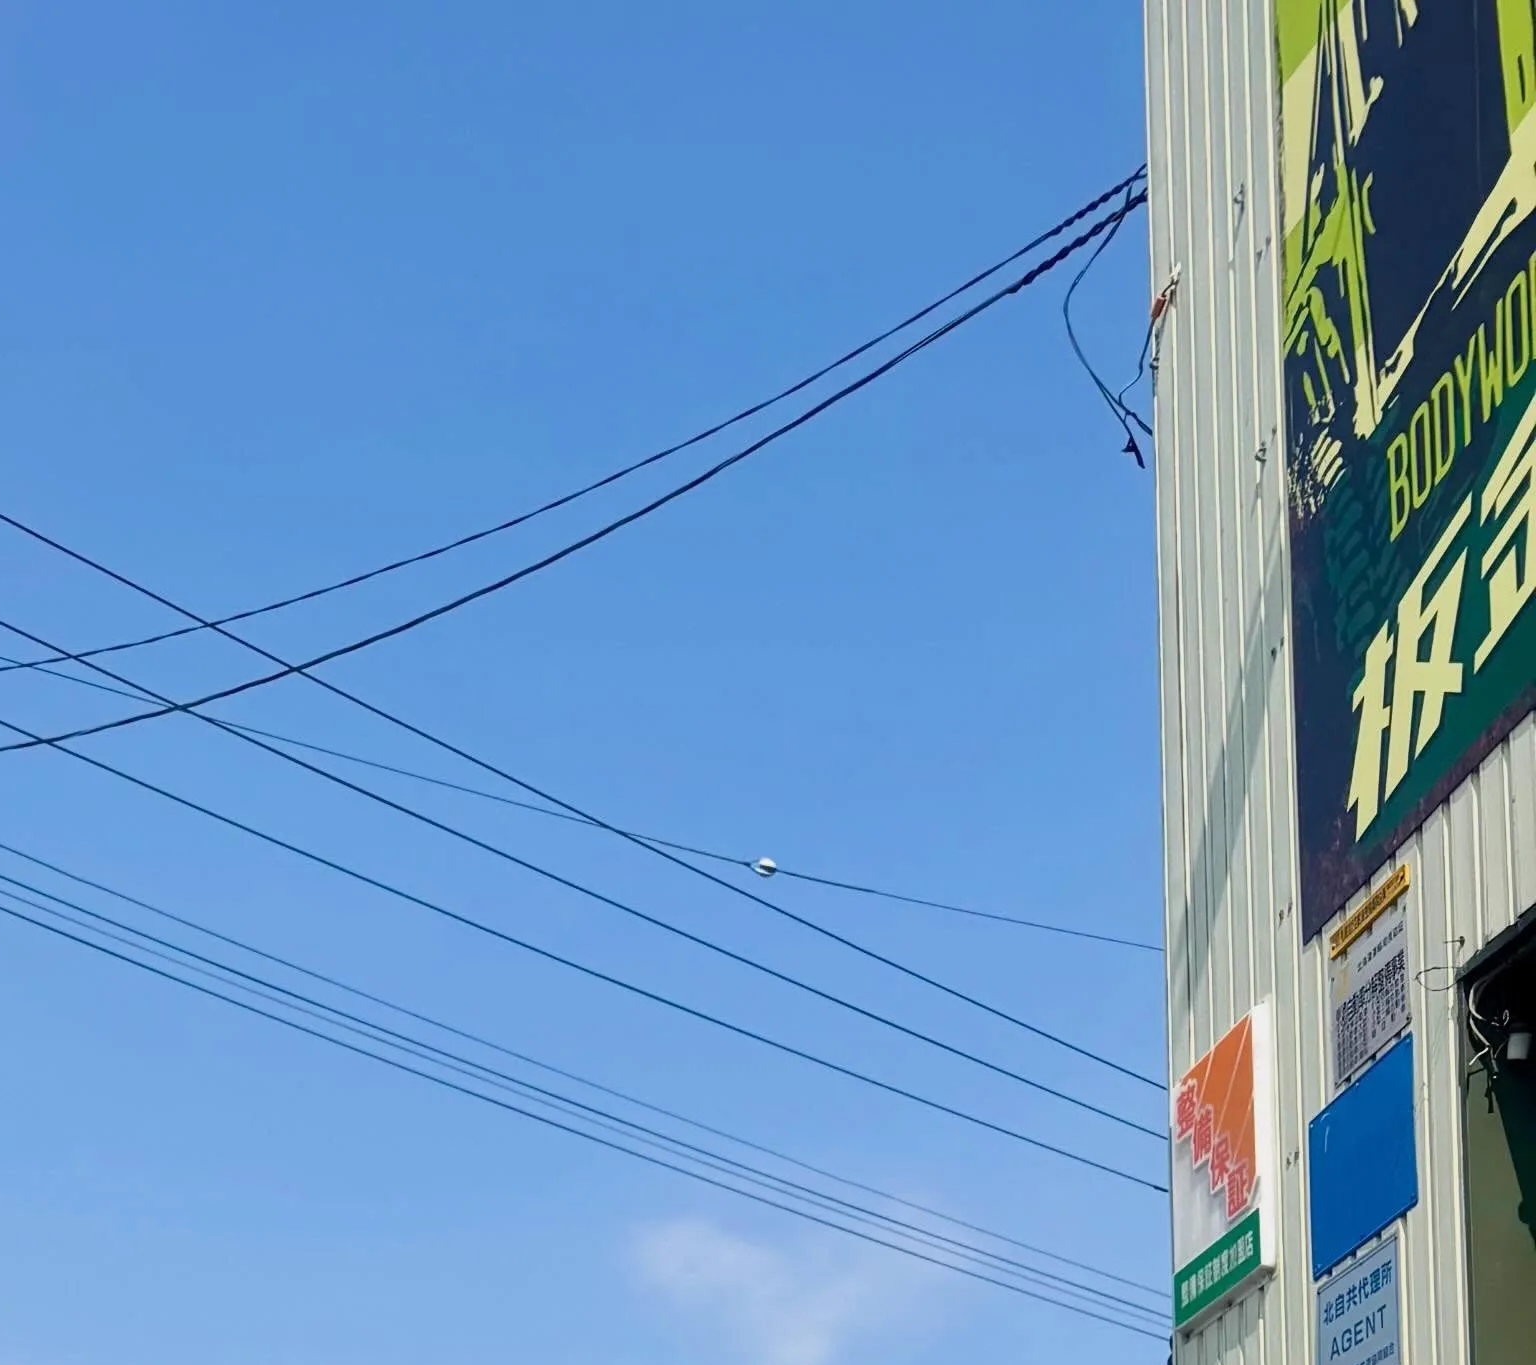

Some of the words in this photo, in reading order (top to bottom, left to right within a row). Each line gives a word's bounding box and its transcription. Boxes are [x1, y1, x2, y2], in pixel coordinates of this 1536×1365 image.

[1176, 1085, 1248, 1218] 整備保証
[1323, 1259, 1392, 1326] 北自共代理所
[1330, 1304, 1387, 1361] AGENT
